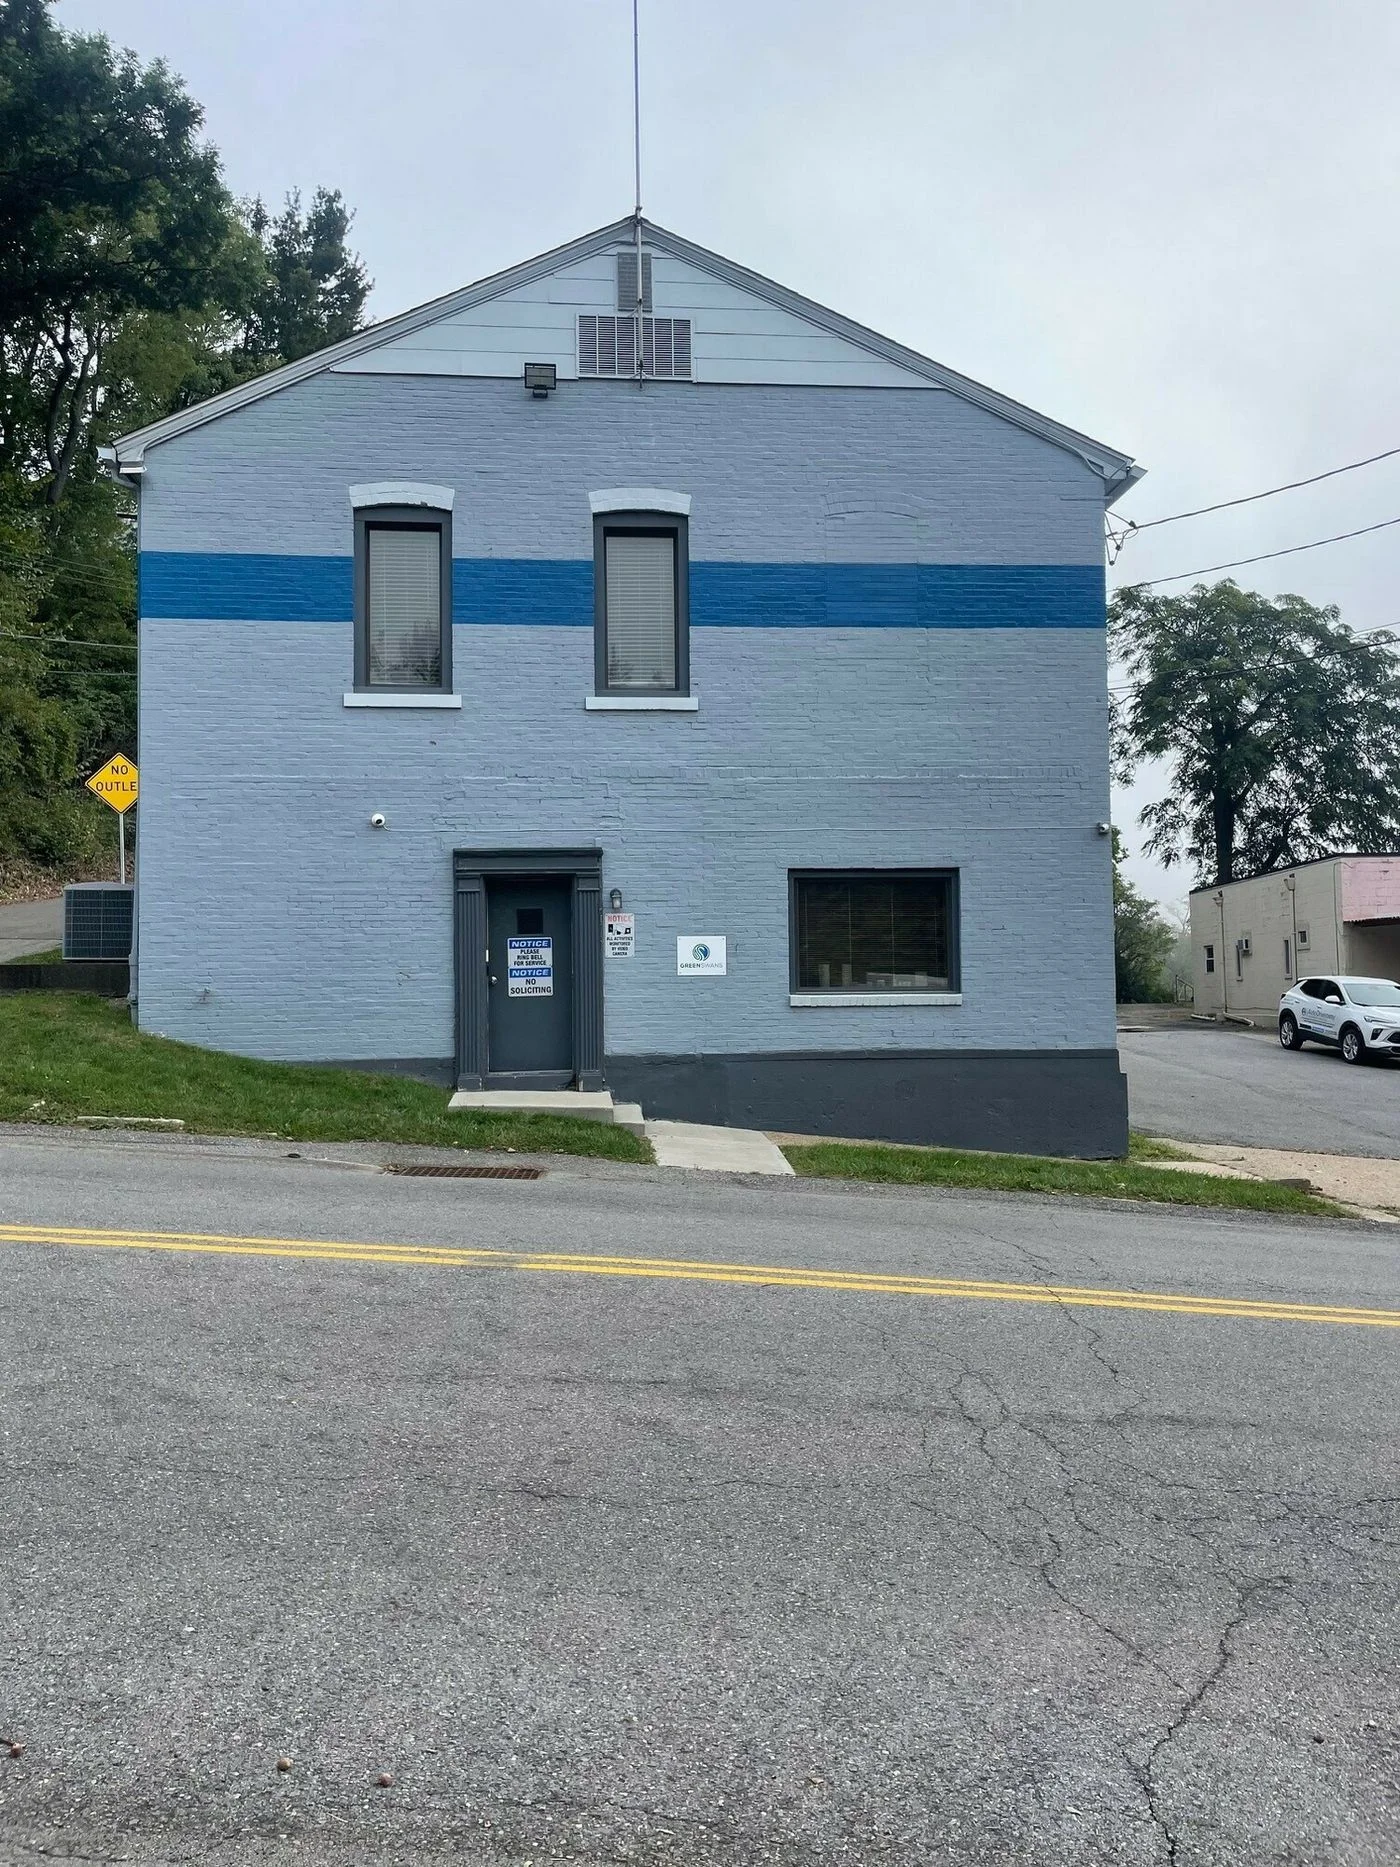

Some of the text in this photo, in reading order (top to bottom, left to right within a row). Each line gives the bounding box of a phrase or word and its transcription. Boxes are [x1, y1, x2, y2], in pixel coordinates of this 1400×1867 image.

[111, 765, 129, 775] NO
[95, 781, 138, 792] OUTLE
[510, 986, 552, 995] SOLICITING
